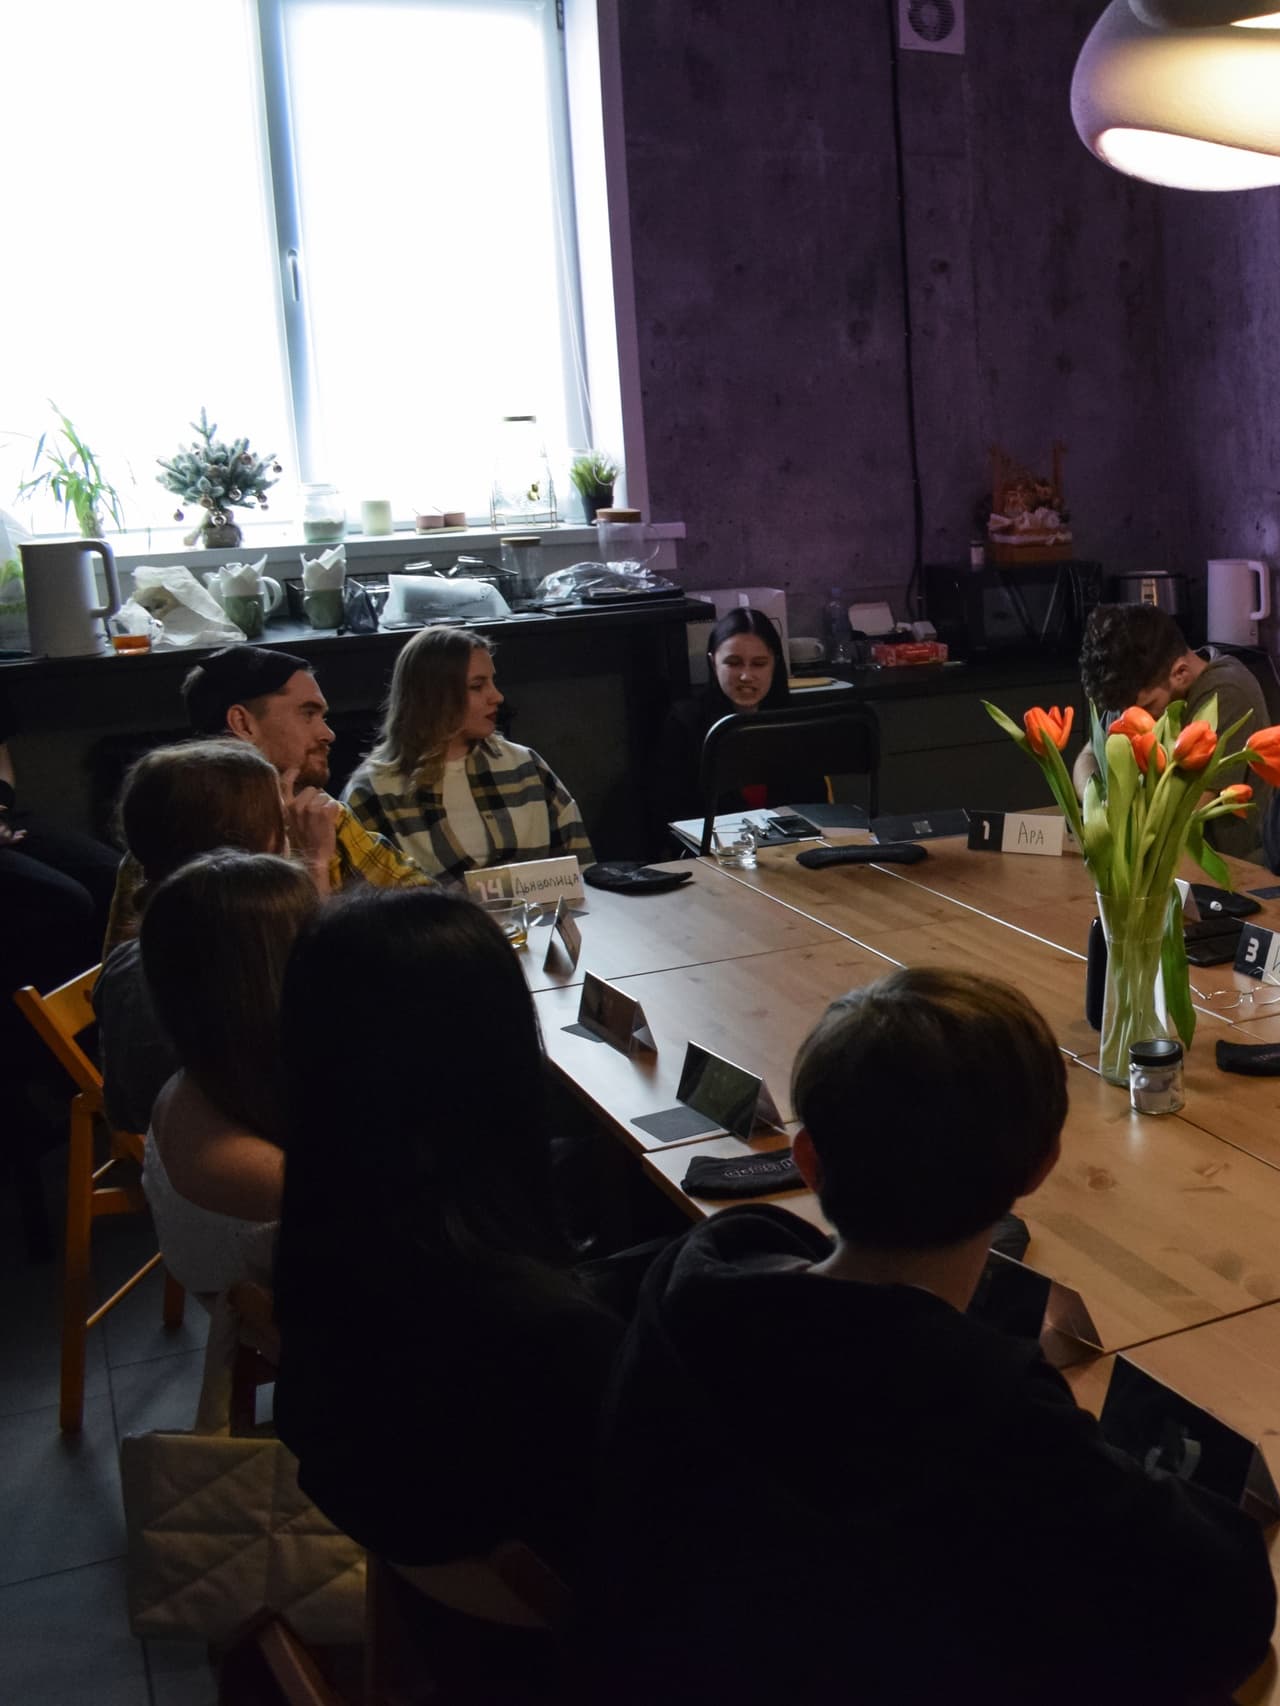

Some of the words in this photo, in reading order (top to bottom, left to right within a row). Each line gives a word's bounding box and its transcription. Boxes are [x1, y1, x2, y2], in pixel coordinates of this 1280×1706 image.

[982, 820, 991, 840] 1
[475, 877, 505, 903] 14
[1244, 937, 1260, 963] 3
